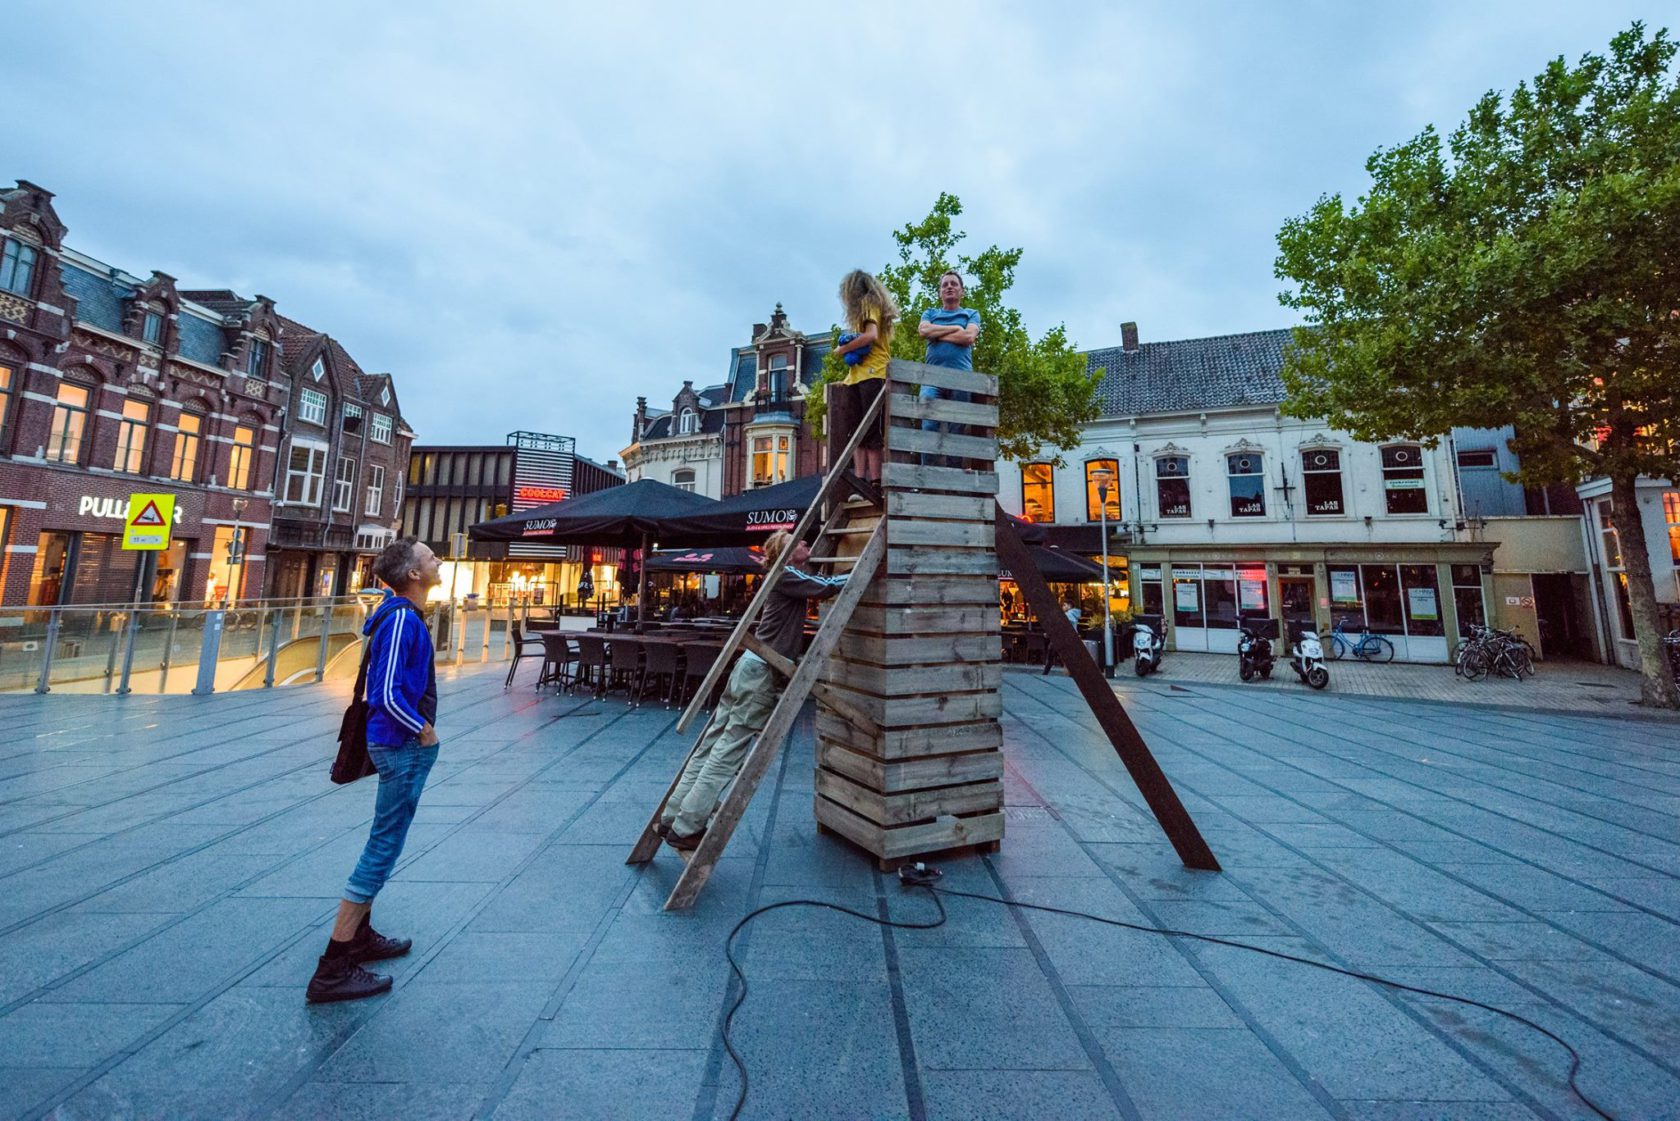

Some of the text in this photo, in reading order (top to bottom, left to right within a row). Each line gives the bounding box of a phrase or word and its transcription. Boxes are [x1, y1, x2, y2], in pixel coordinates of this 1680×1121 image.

[520, 487, 565, 499] COOLCAT
[746, 510, 787, 525] SUMO
[523, 519, 551, 530] SUMO
